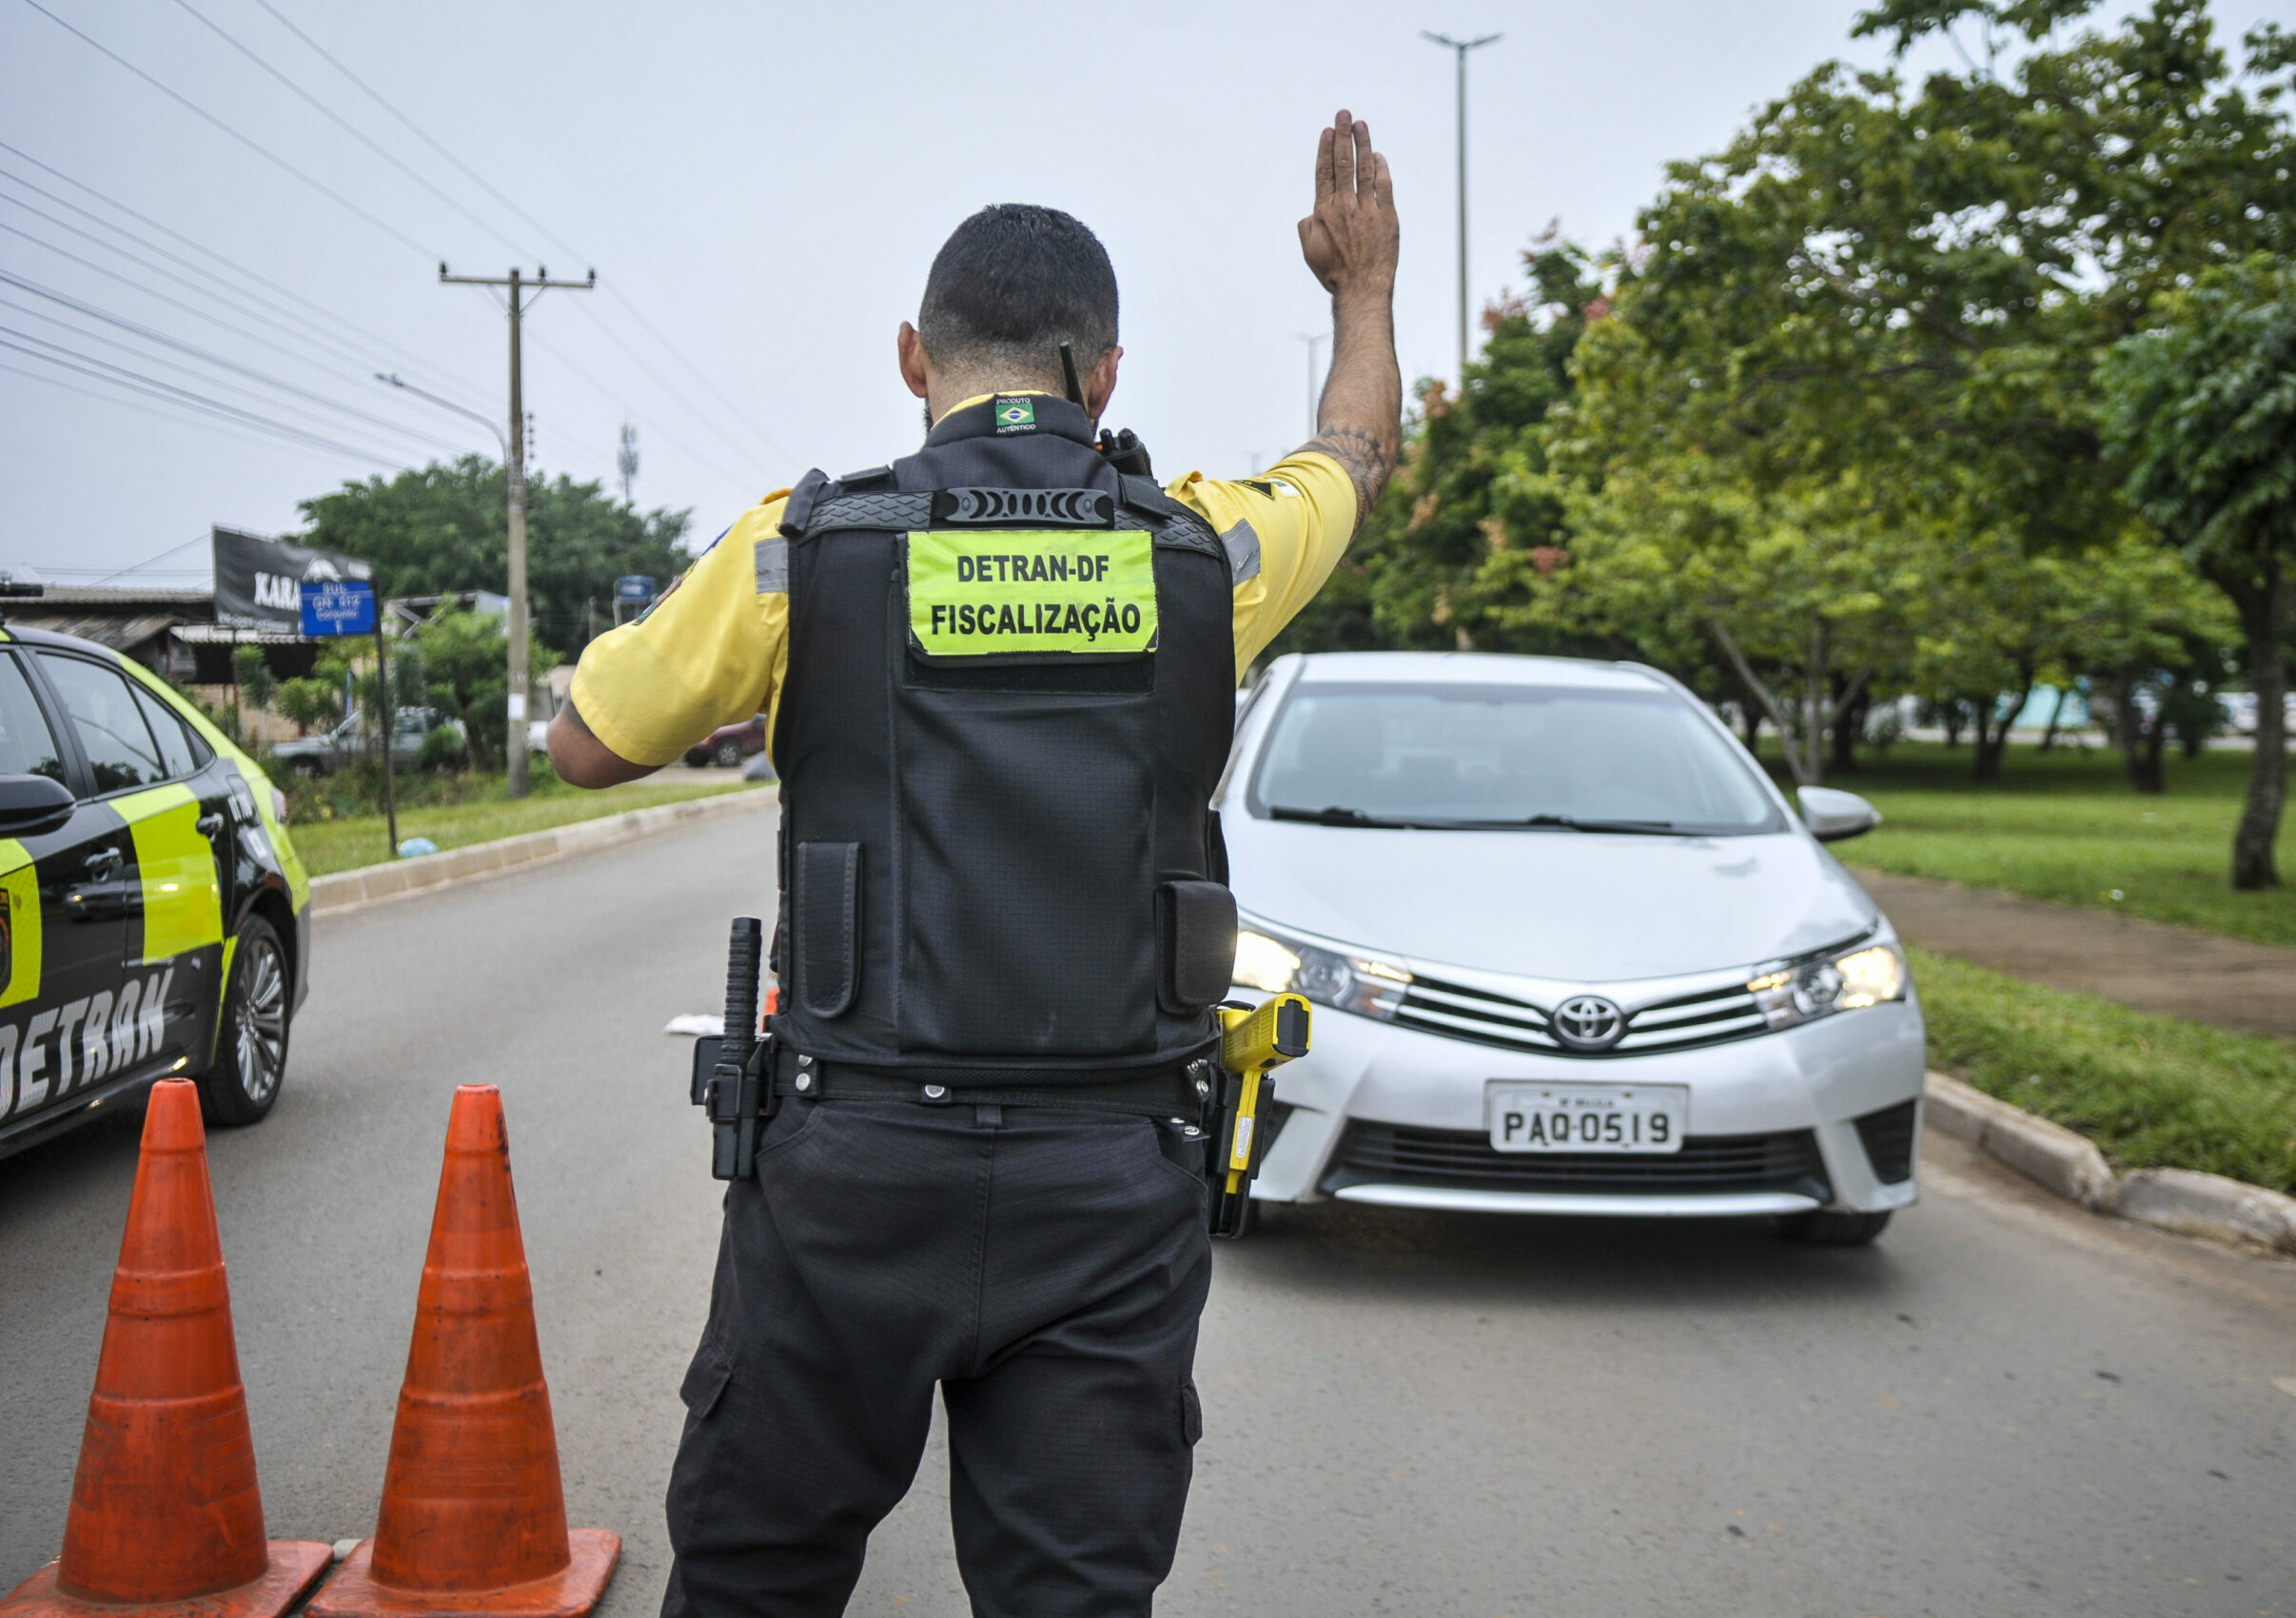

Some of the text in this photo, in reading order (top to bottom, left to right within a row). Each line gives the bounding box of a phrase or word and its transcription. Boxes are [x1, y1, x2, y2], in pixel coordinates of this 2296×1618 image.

[996, 397, 1030, 405] PRODUTO
[957, 555, 1109, 582] DETRAN-DF
[931, 597, 1140, 641] FISCALIZAÇÃO
